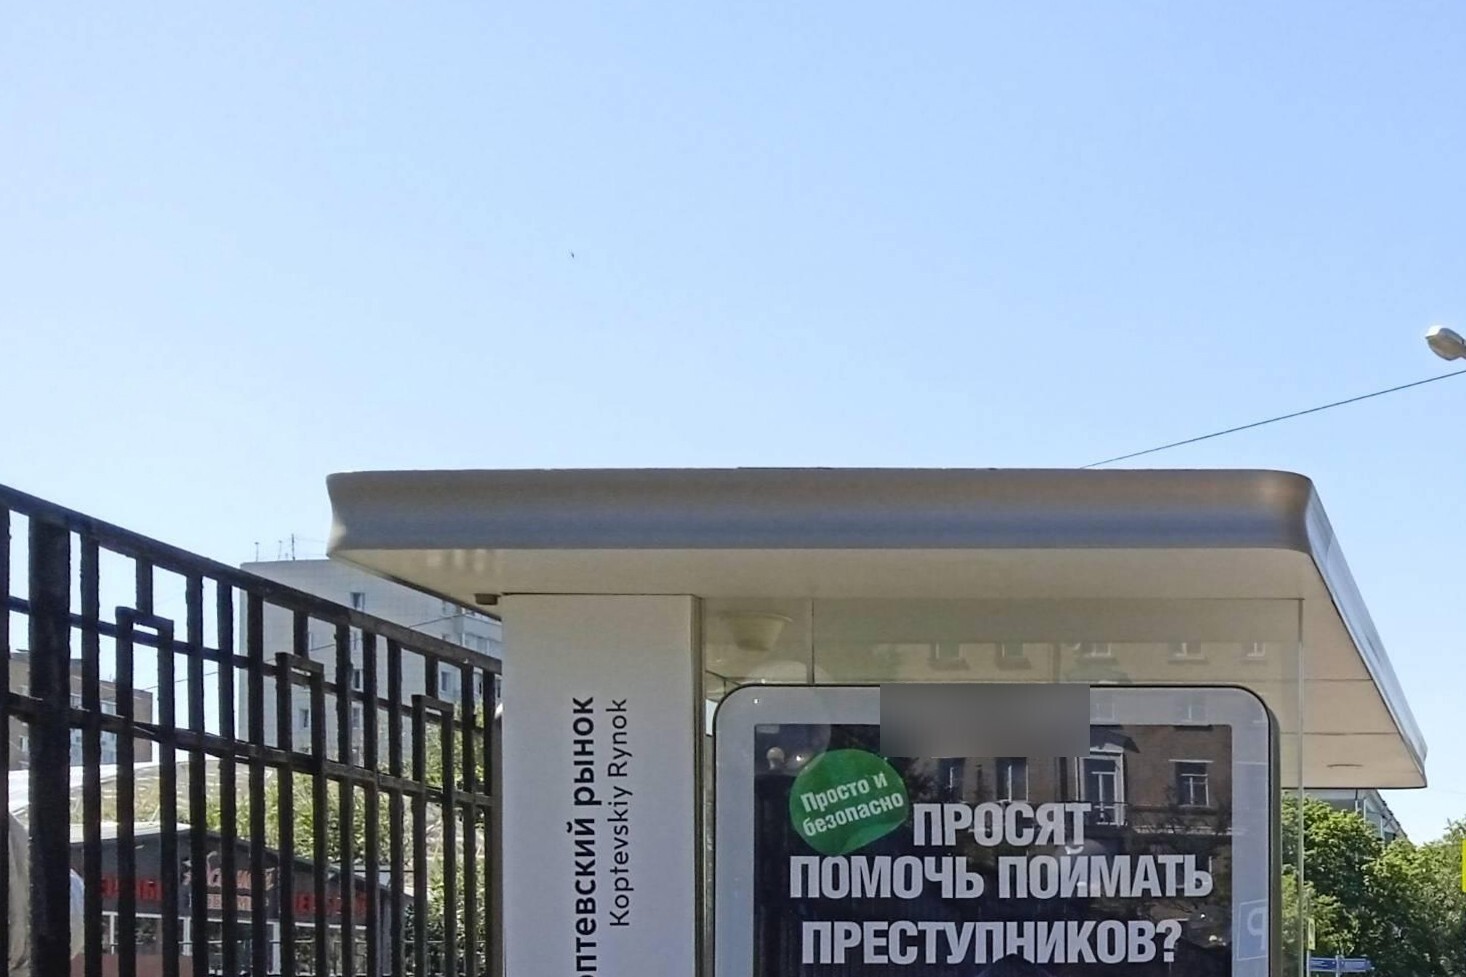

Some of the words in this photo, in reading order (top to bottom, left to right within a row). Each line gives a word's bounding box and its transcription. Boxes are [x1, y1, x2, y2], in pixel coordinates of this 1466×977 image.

[571, 696, 603, 807] рынок
[605, 697, 634, 778] Rynok
[800, 778, 871, 814] Просто
[873, 770, 889, 788] и
[801, 789, 905, 838] безопасно
[912, 800, 1093, 848] ПРОСЯТ
[607, 785, 635, 928] Koptevskiy
[788, 854, 985, 899] ПОМОЧЬ
[997, 843, 1214, 899] ПОЙМАТЬ
[801, 918, 1184, 965] ПРЕСТУПНИКОВ?
